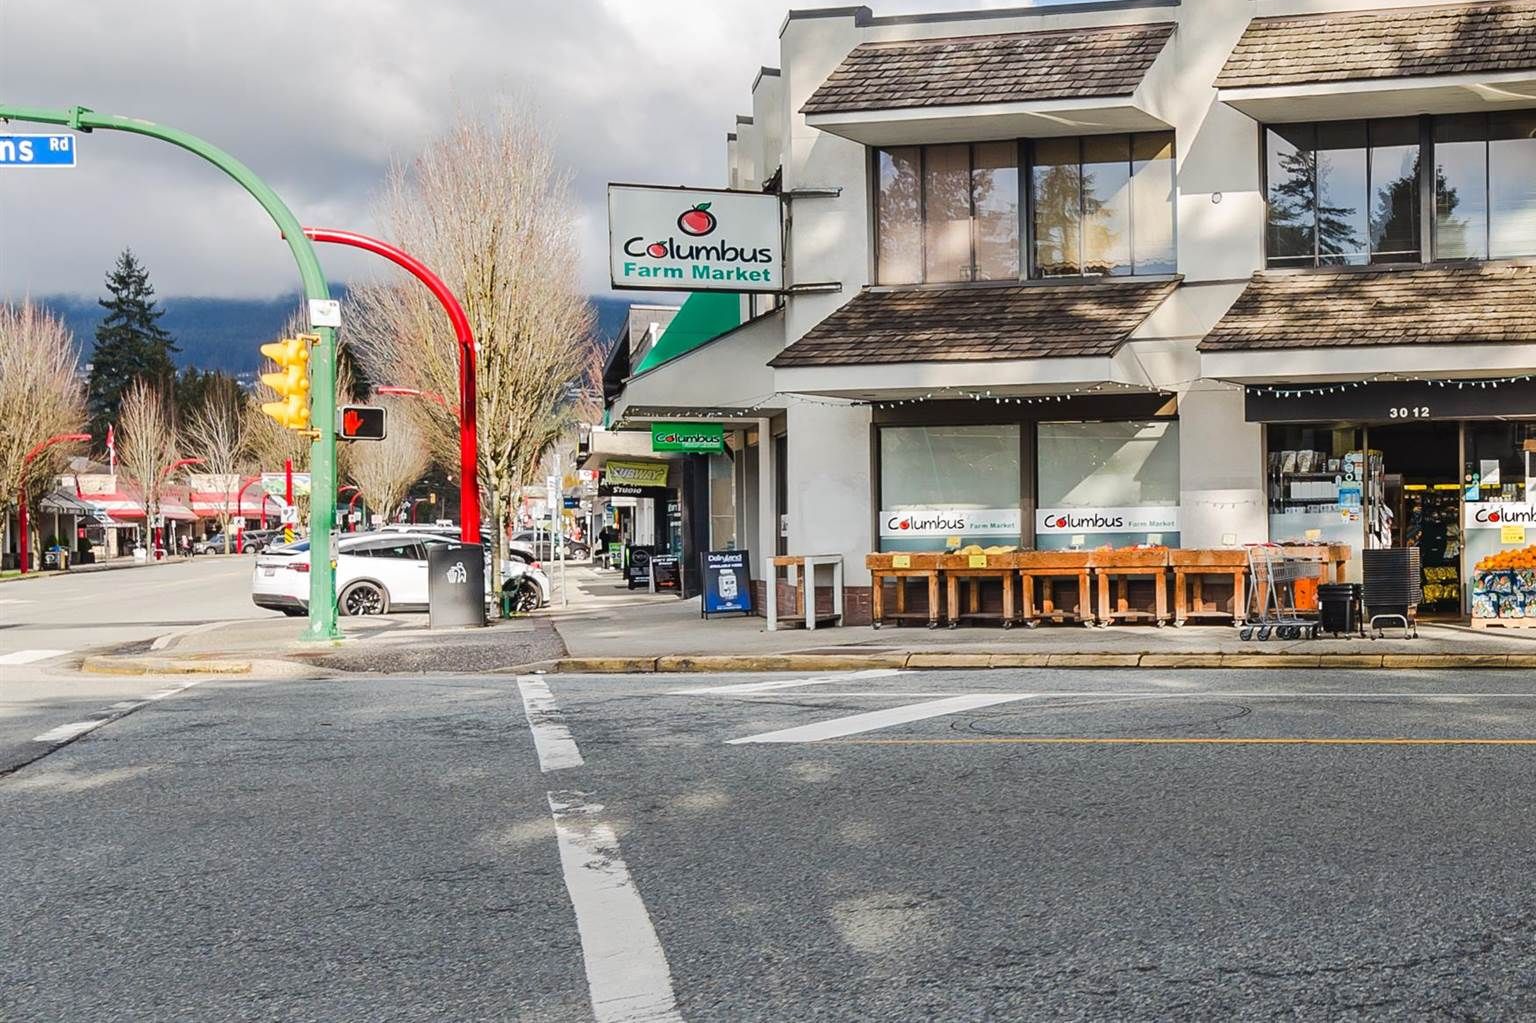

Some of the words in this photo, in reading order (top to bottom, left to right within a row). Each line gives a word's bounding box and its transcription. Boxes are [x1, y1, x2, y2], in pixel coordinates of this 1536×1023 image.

[49, 136, 69, 151] Rd
[623, 237, 772, 263] Columbus
[624, 262, 683, 279] Farm
[692, 264, 771, 282] Market
[656, 432, 720, 443] Columbus
[613, 467, 664, 481] SUBWAY
[888, 515, 965, 530] Columbus
[1044, 514, 1123, 528] Columbus
